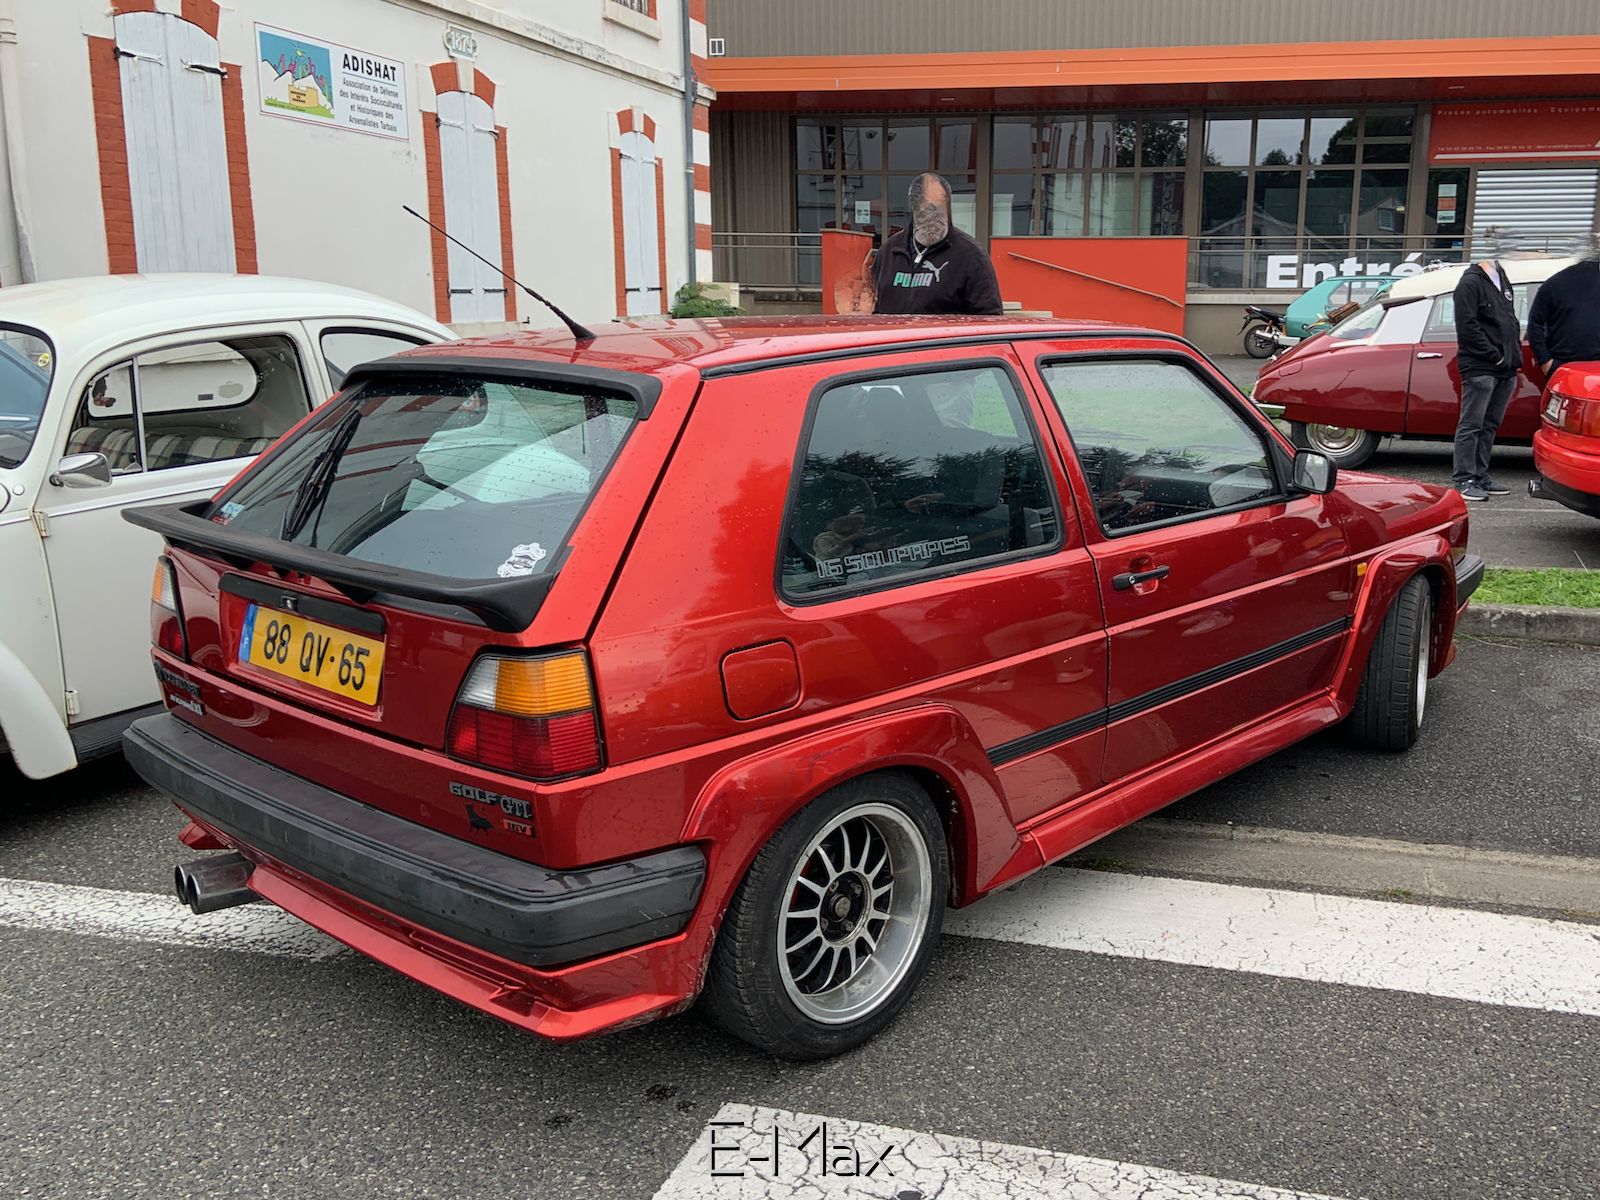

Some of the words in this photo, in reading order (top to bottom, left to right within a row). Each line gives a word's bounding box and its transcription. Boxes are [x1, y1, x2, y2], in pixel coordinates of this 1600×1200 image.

[450, 31, 473, 54] 1879
[342, 53, 396, 82] ADISHAT
[342, 77, 371, 91] Association
[372, 84, 379, 93] de
[339, 89, 349, 98] des
[370, 95, 403, 111] Socioculturels
[350, 103, 356, 111] et
[357, 104, 384, 118] Historiques
[385, 111, 394, 120] des
[349, 114, 379, 129] Arsenalistes
[380, 120, 397, 132] Tarbais
[893, 272, 934, 288] PUMA
[815, 557, 843, 578] 16
[844, 535, 971, 573] SOUPAPES
[263, 619, 291, 665] 88
[449, 781, 498, 804] GOLF
[500, 795, 532, 819] GTI
